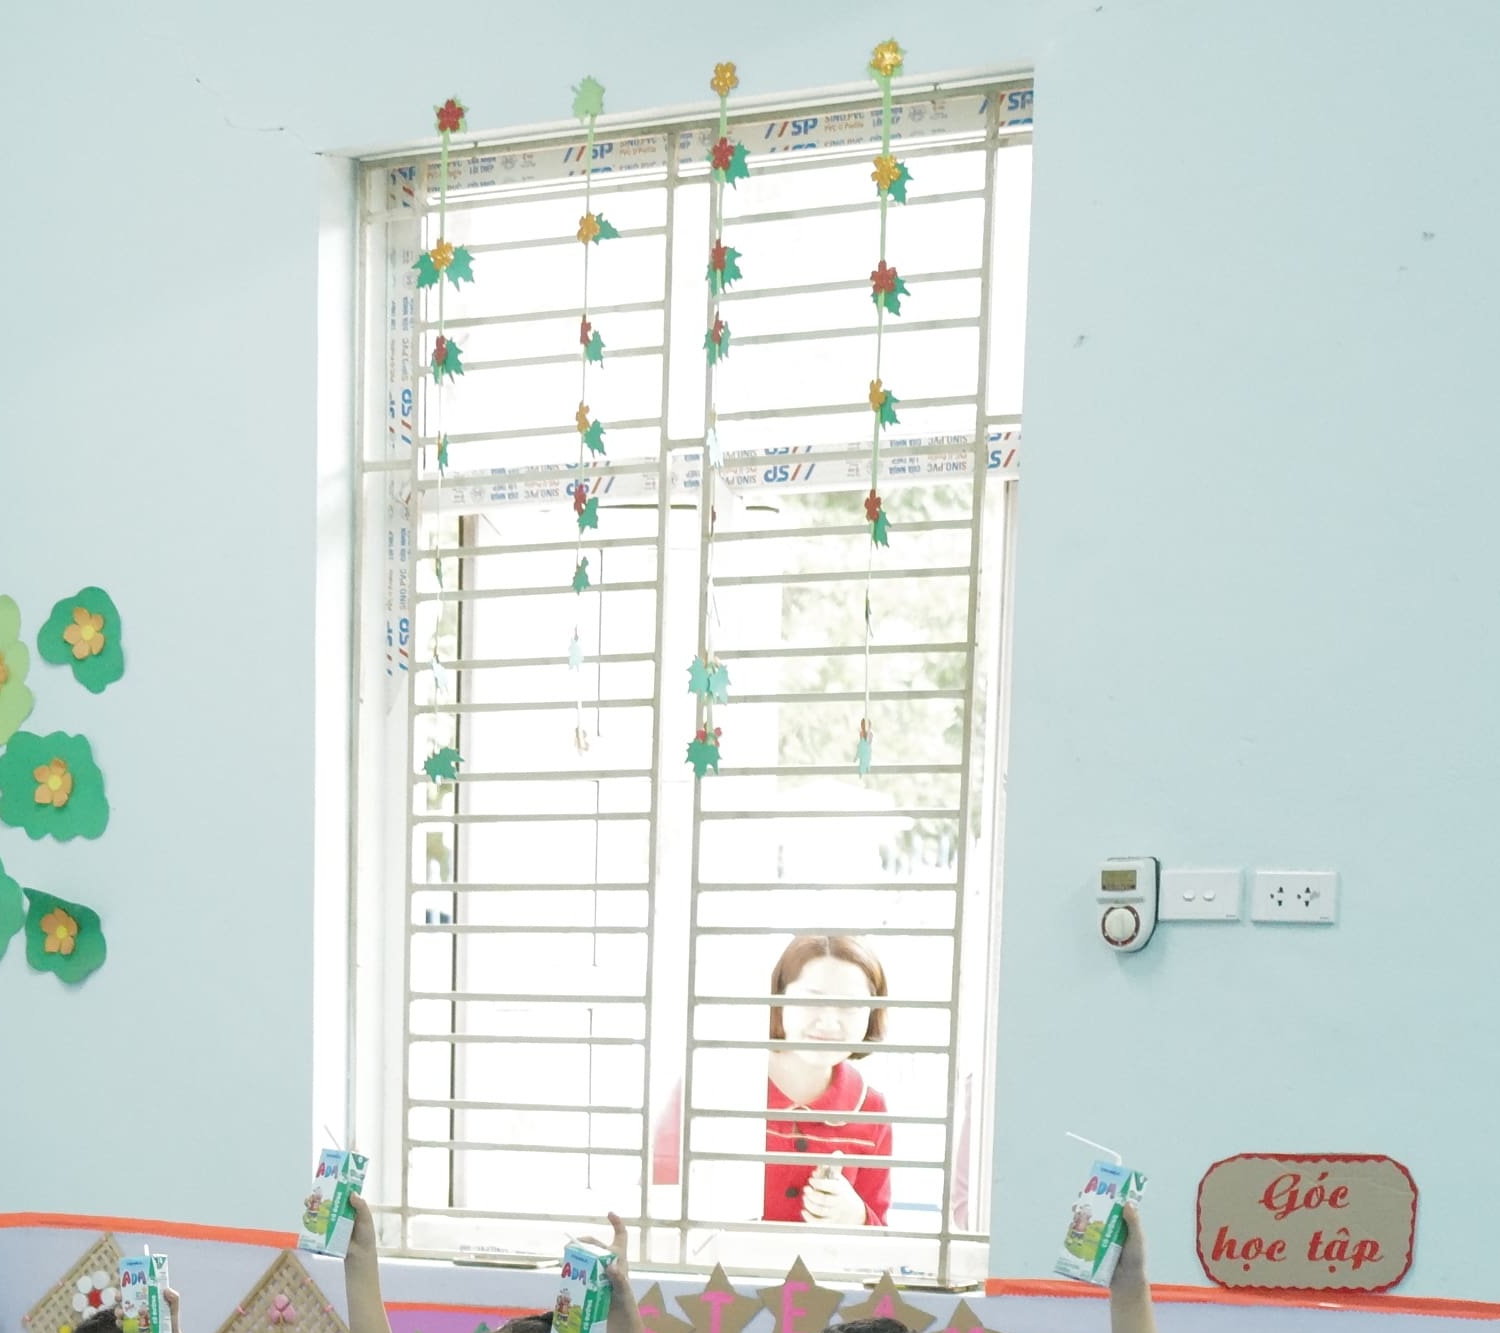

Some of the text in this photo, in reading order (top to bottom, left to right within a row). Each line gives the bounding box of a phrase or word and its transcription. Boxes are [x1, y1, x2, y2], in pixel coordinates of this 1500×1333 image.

[1258, 1171, 1350, 1221] Góc
[1211, 1225, 1385, 1274] học tập
[121, 1270, 147, 1288] ADM
